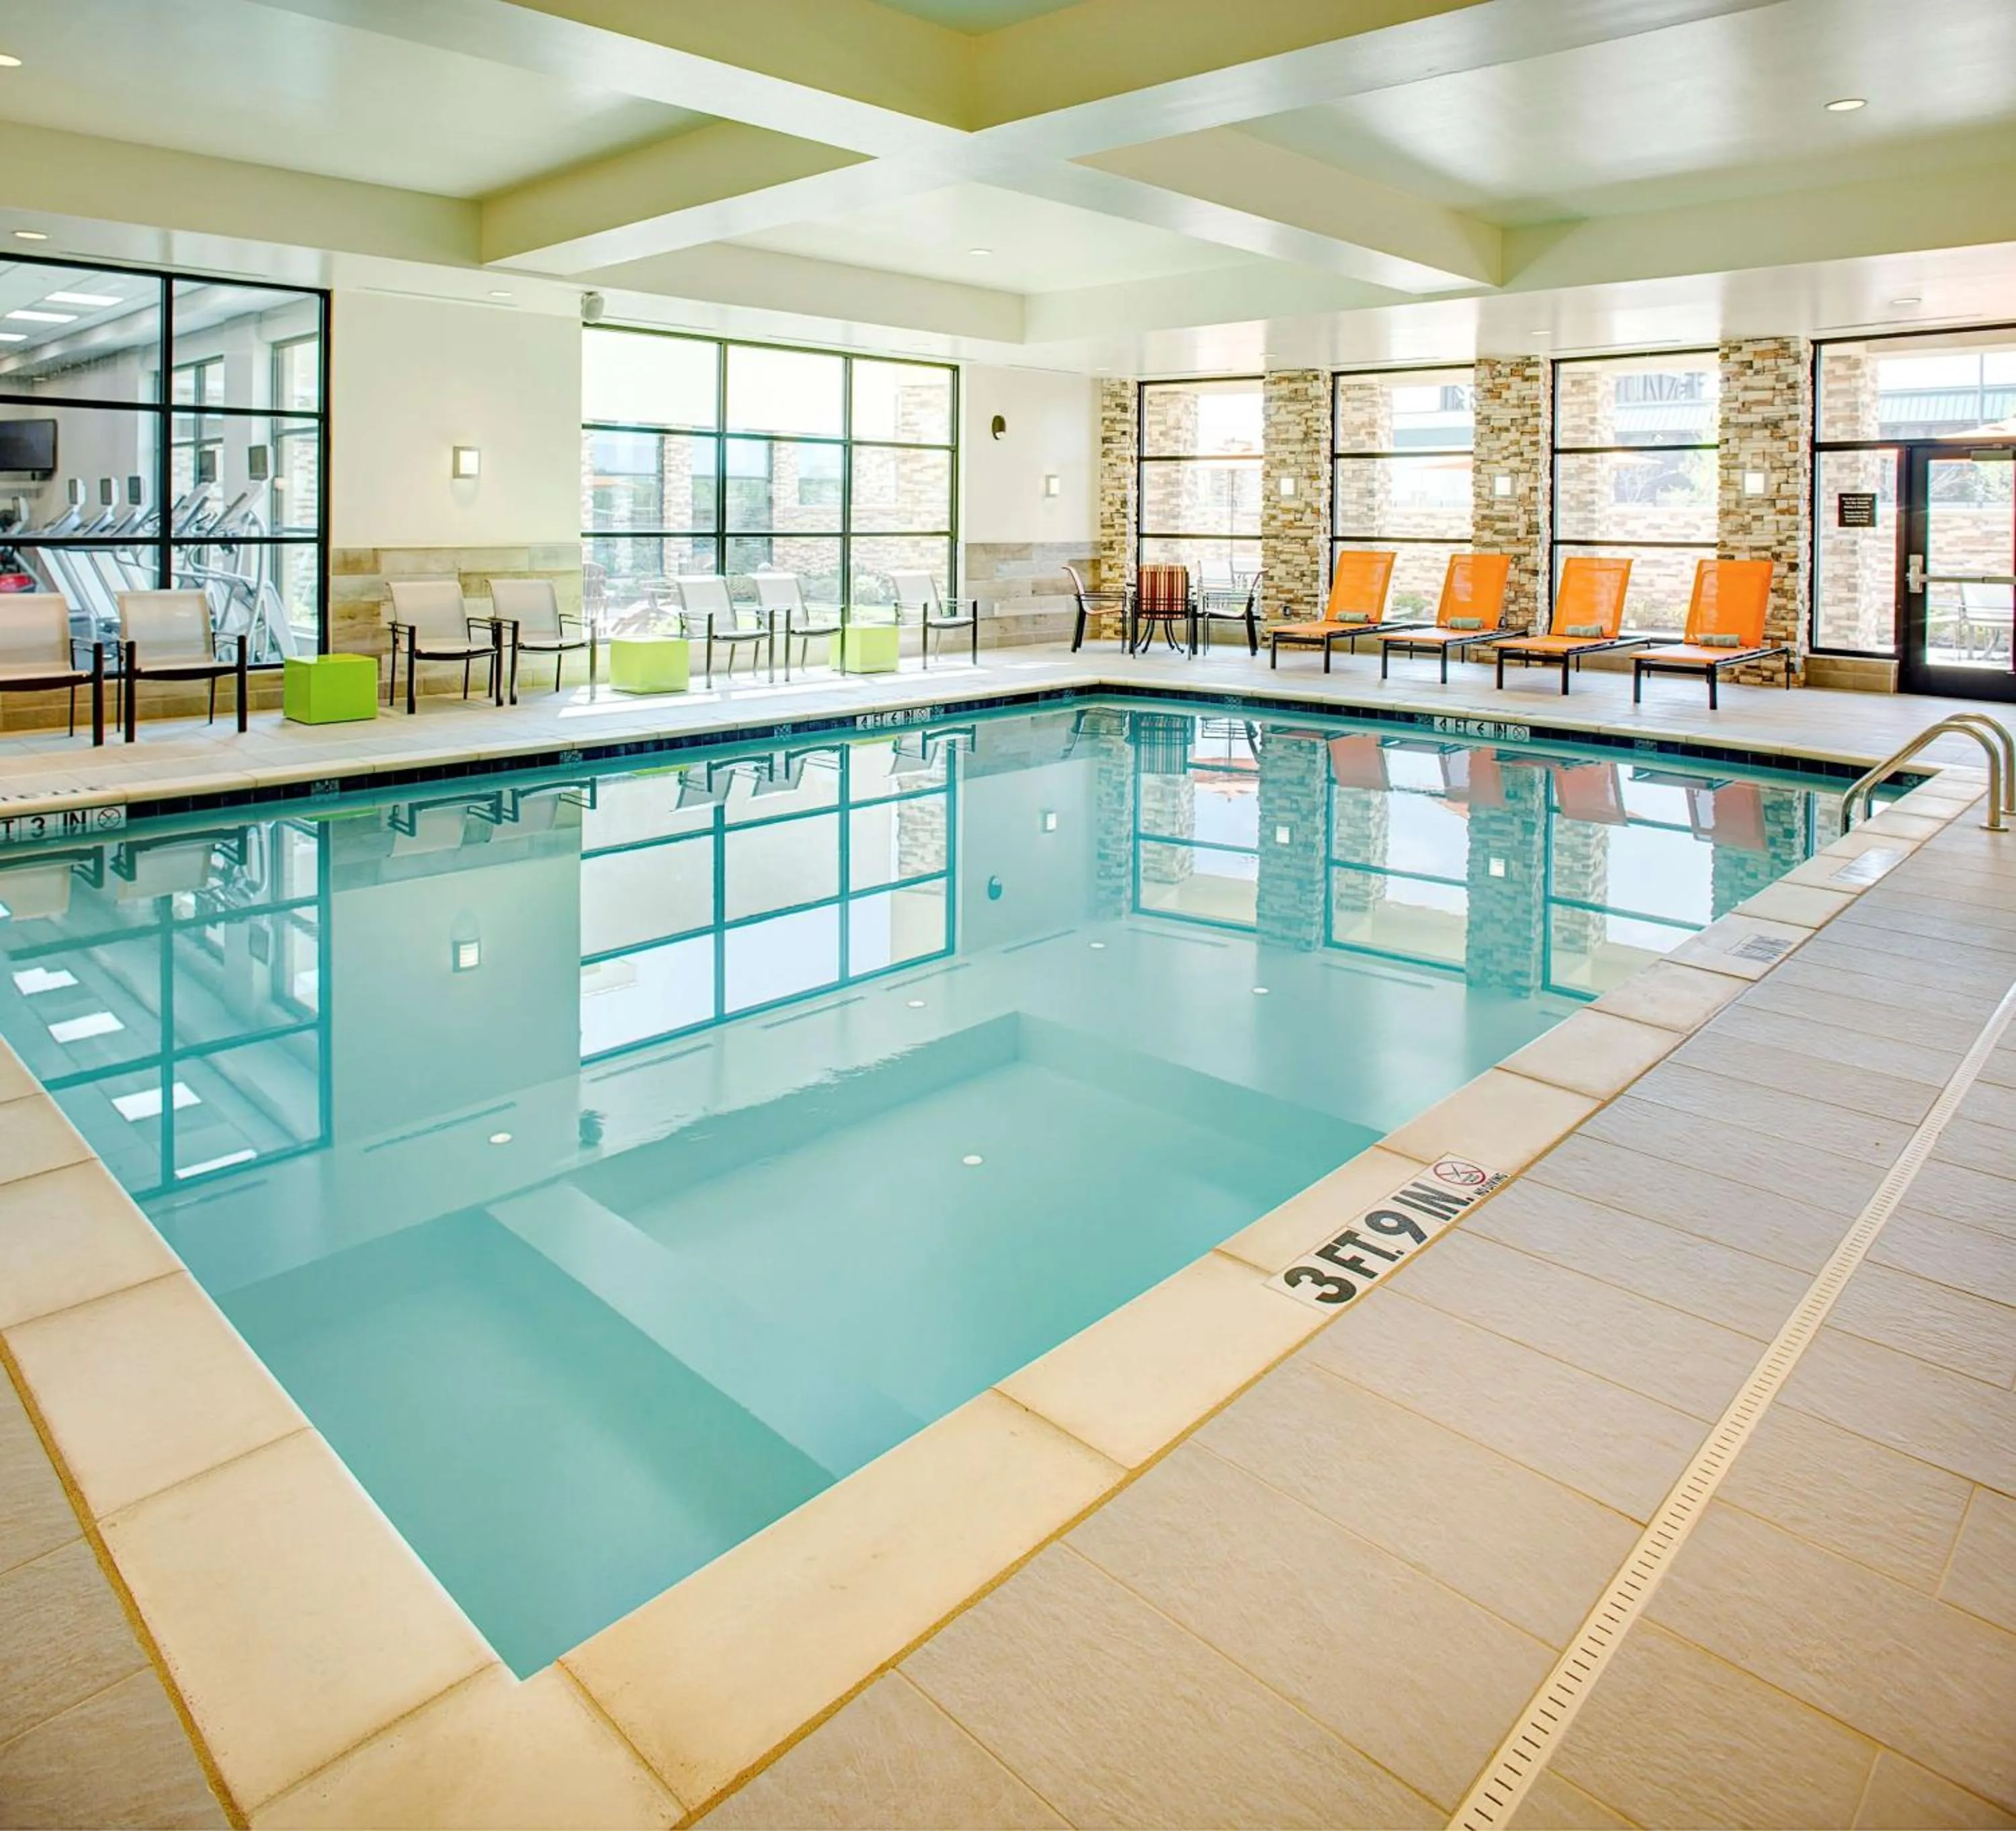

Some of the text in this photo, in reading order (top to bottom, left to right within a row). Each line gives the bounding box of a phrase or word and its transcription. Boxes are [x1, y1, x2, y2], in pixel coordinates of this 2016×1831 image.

[0, 819, 15, 834] T
[63, 811, 87, 826] IN
[1391, 1182, 1475, 1221] IN.
[1365, 1210, 1427, 1245] 9
[1315, 1229, 1405, 1279] FT.
[1284, 1266, 1357, 1303] 3
